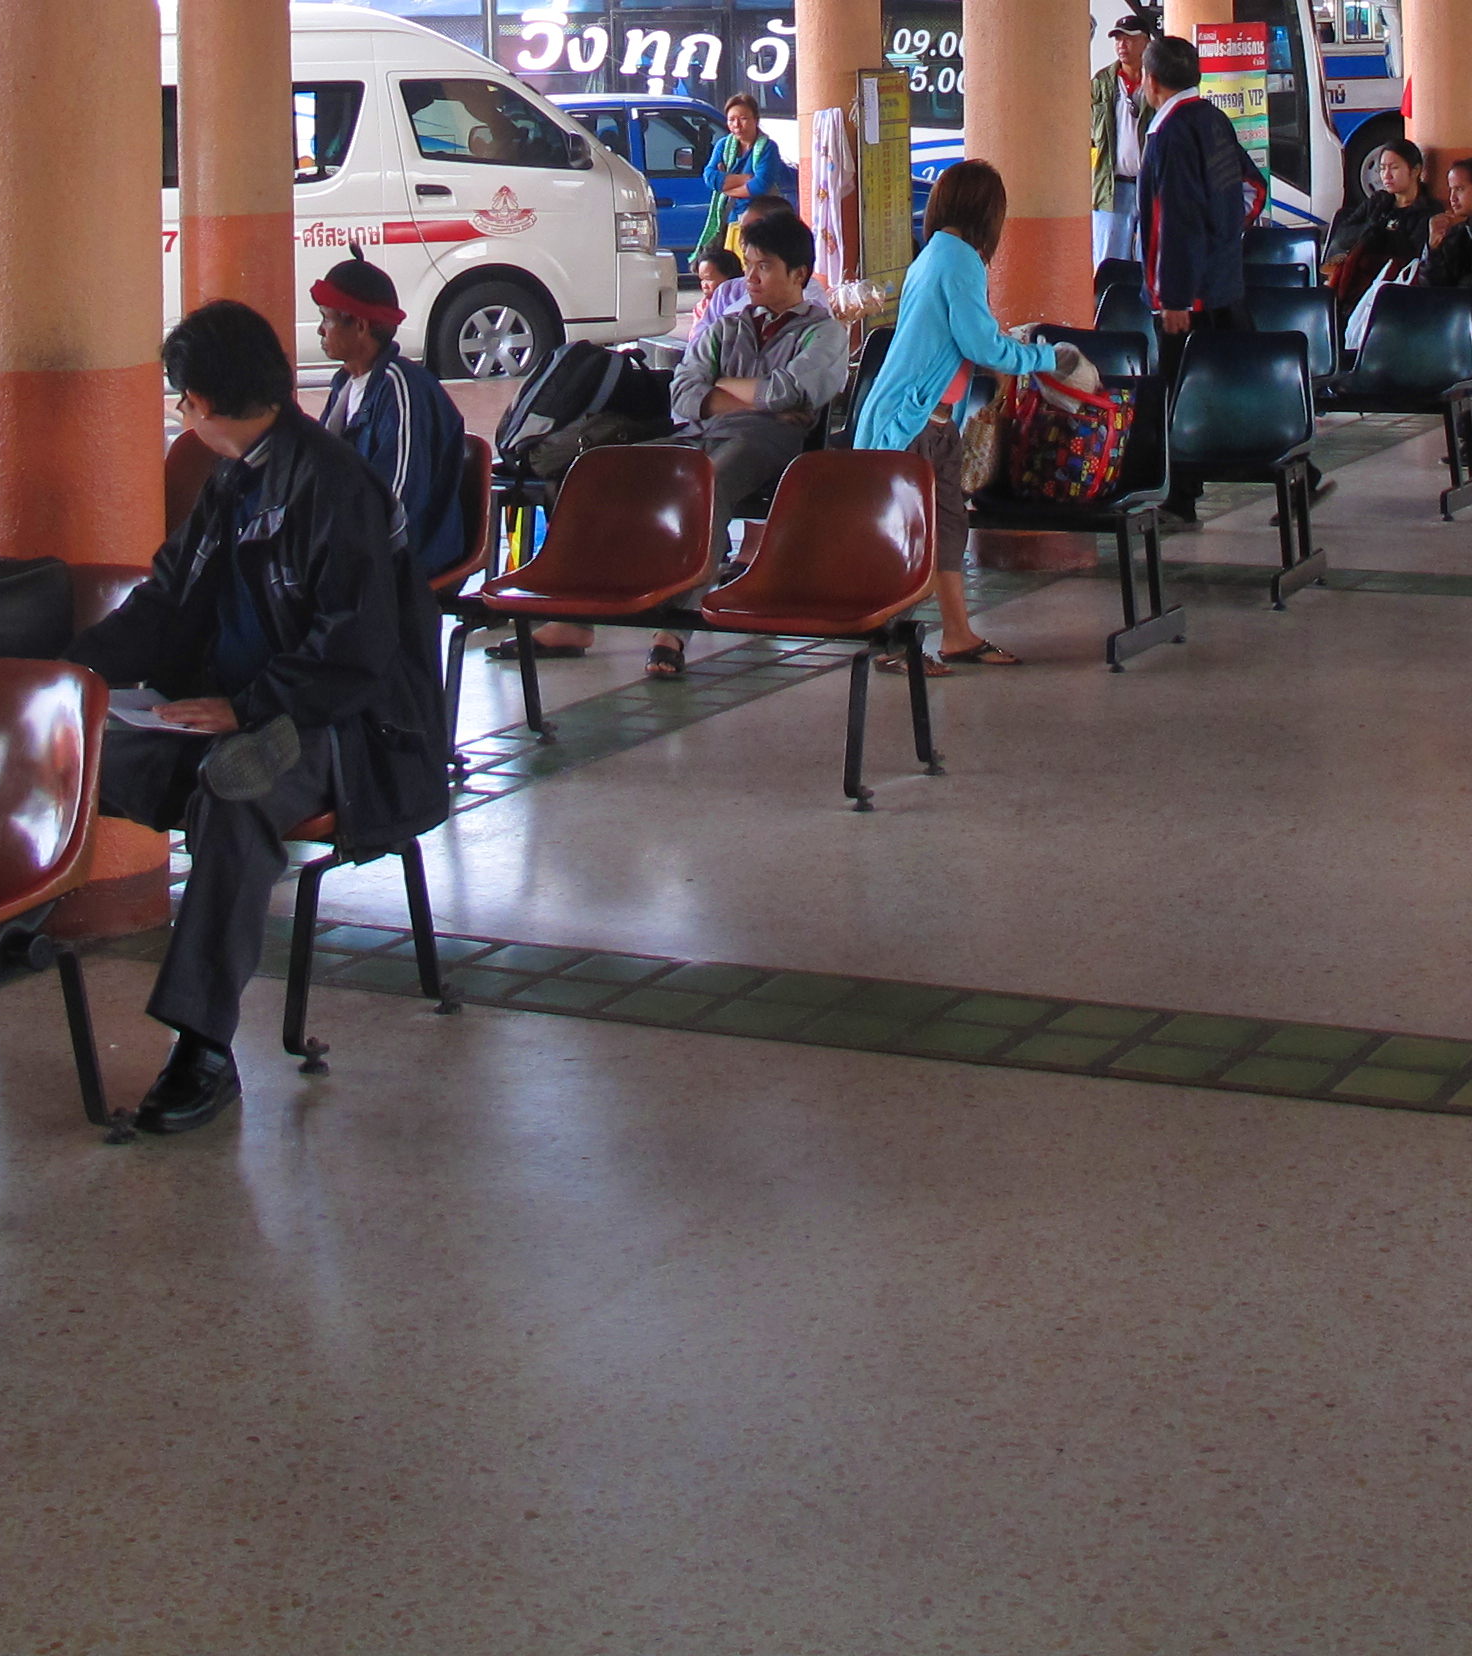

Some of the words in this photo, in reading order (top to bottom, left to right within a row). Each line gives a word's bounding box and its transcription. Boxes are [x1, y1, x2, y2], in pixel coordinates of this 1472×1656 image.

[893, 28, 963, 57] 09.0
[620, 28, 722, 95] ทุก
[1248, 88, 1264, 106] VIP
